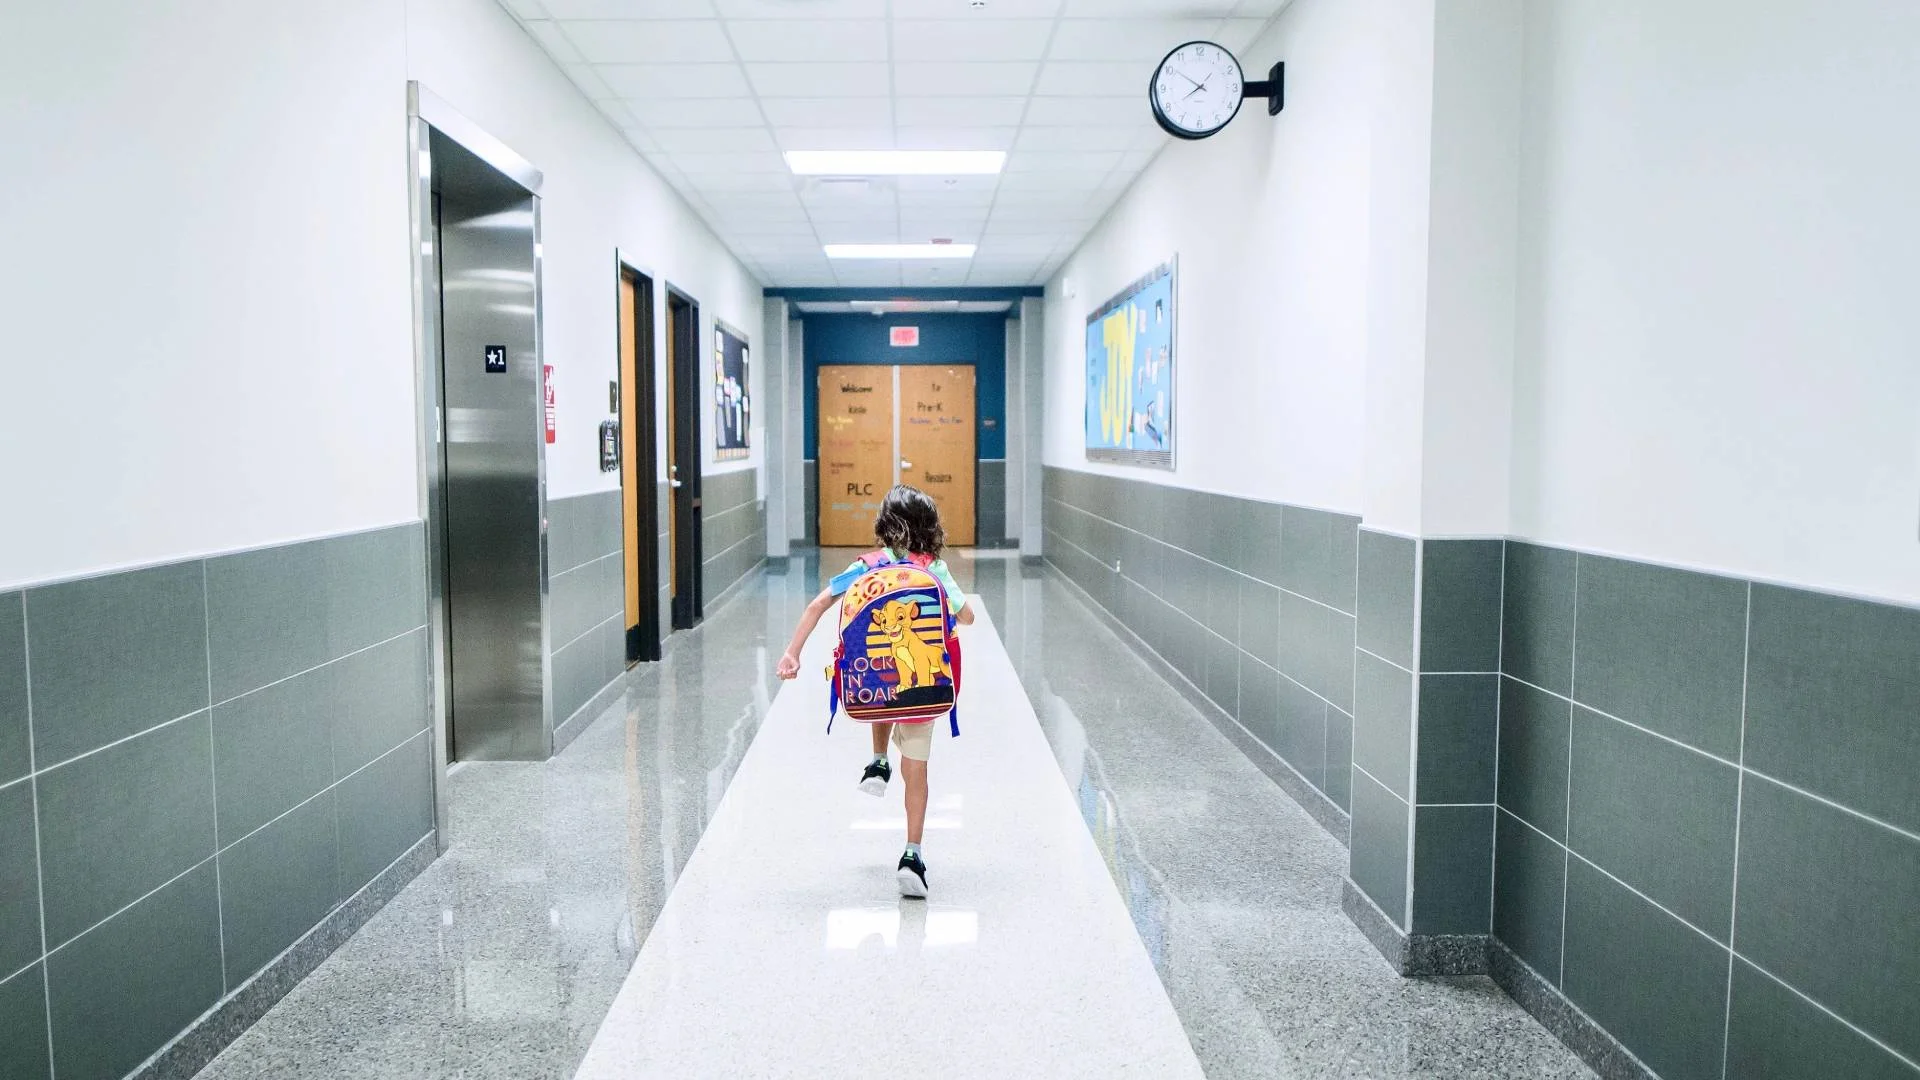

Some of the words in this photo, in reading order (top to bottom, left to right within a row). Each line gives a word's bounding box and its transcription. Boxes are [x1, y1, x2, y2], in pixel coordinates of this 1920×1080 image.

[1177, 52, 1185, 60] 11
[1195, 47, 1205, 56] 12
[1165, 65, 1174, 75] 10
[1227, 65, 1233, 75] 2
[1160, 84, 1166, 93] 9
[1232, 83, 1238, 93] 3
[1165, 103, 1171, 112] 8
[1227, 101, 1233, 110] 4
[1196, 119, 1203, 128] 6
[1215, 114, 1221, 123] 5
[498, 349, 505, 365] 1
[1101, 303, 1138, 450] JOY
[917, 401, 943, 412] Pre-K
[847, 483, 872, 495] PLC
[849, 656, 894, 672] OCK
[846, 687, 897, 703] ROAR
